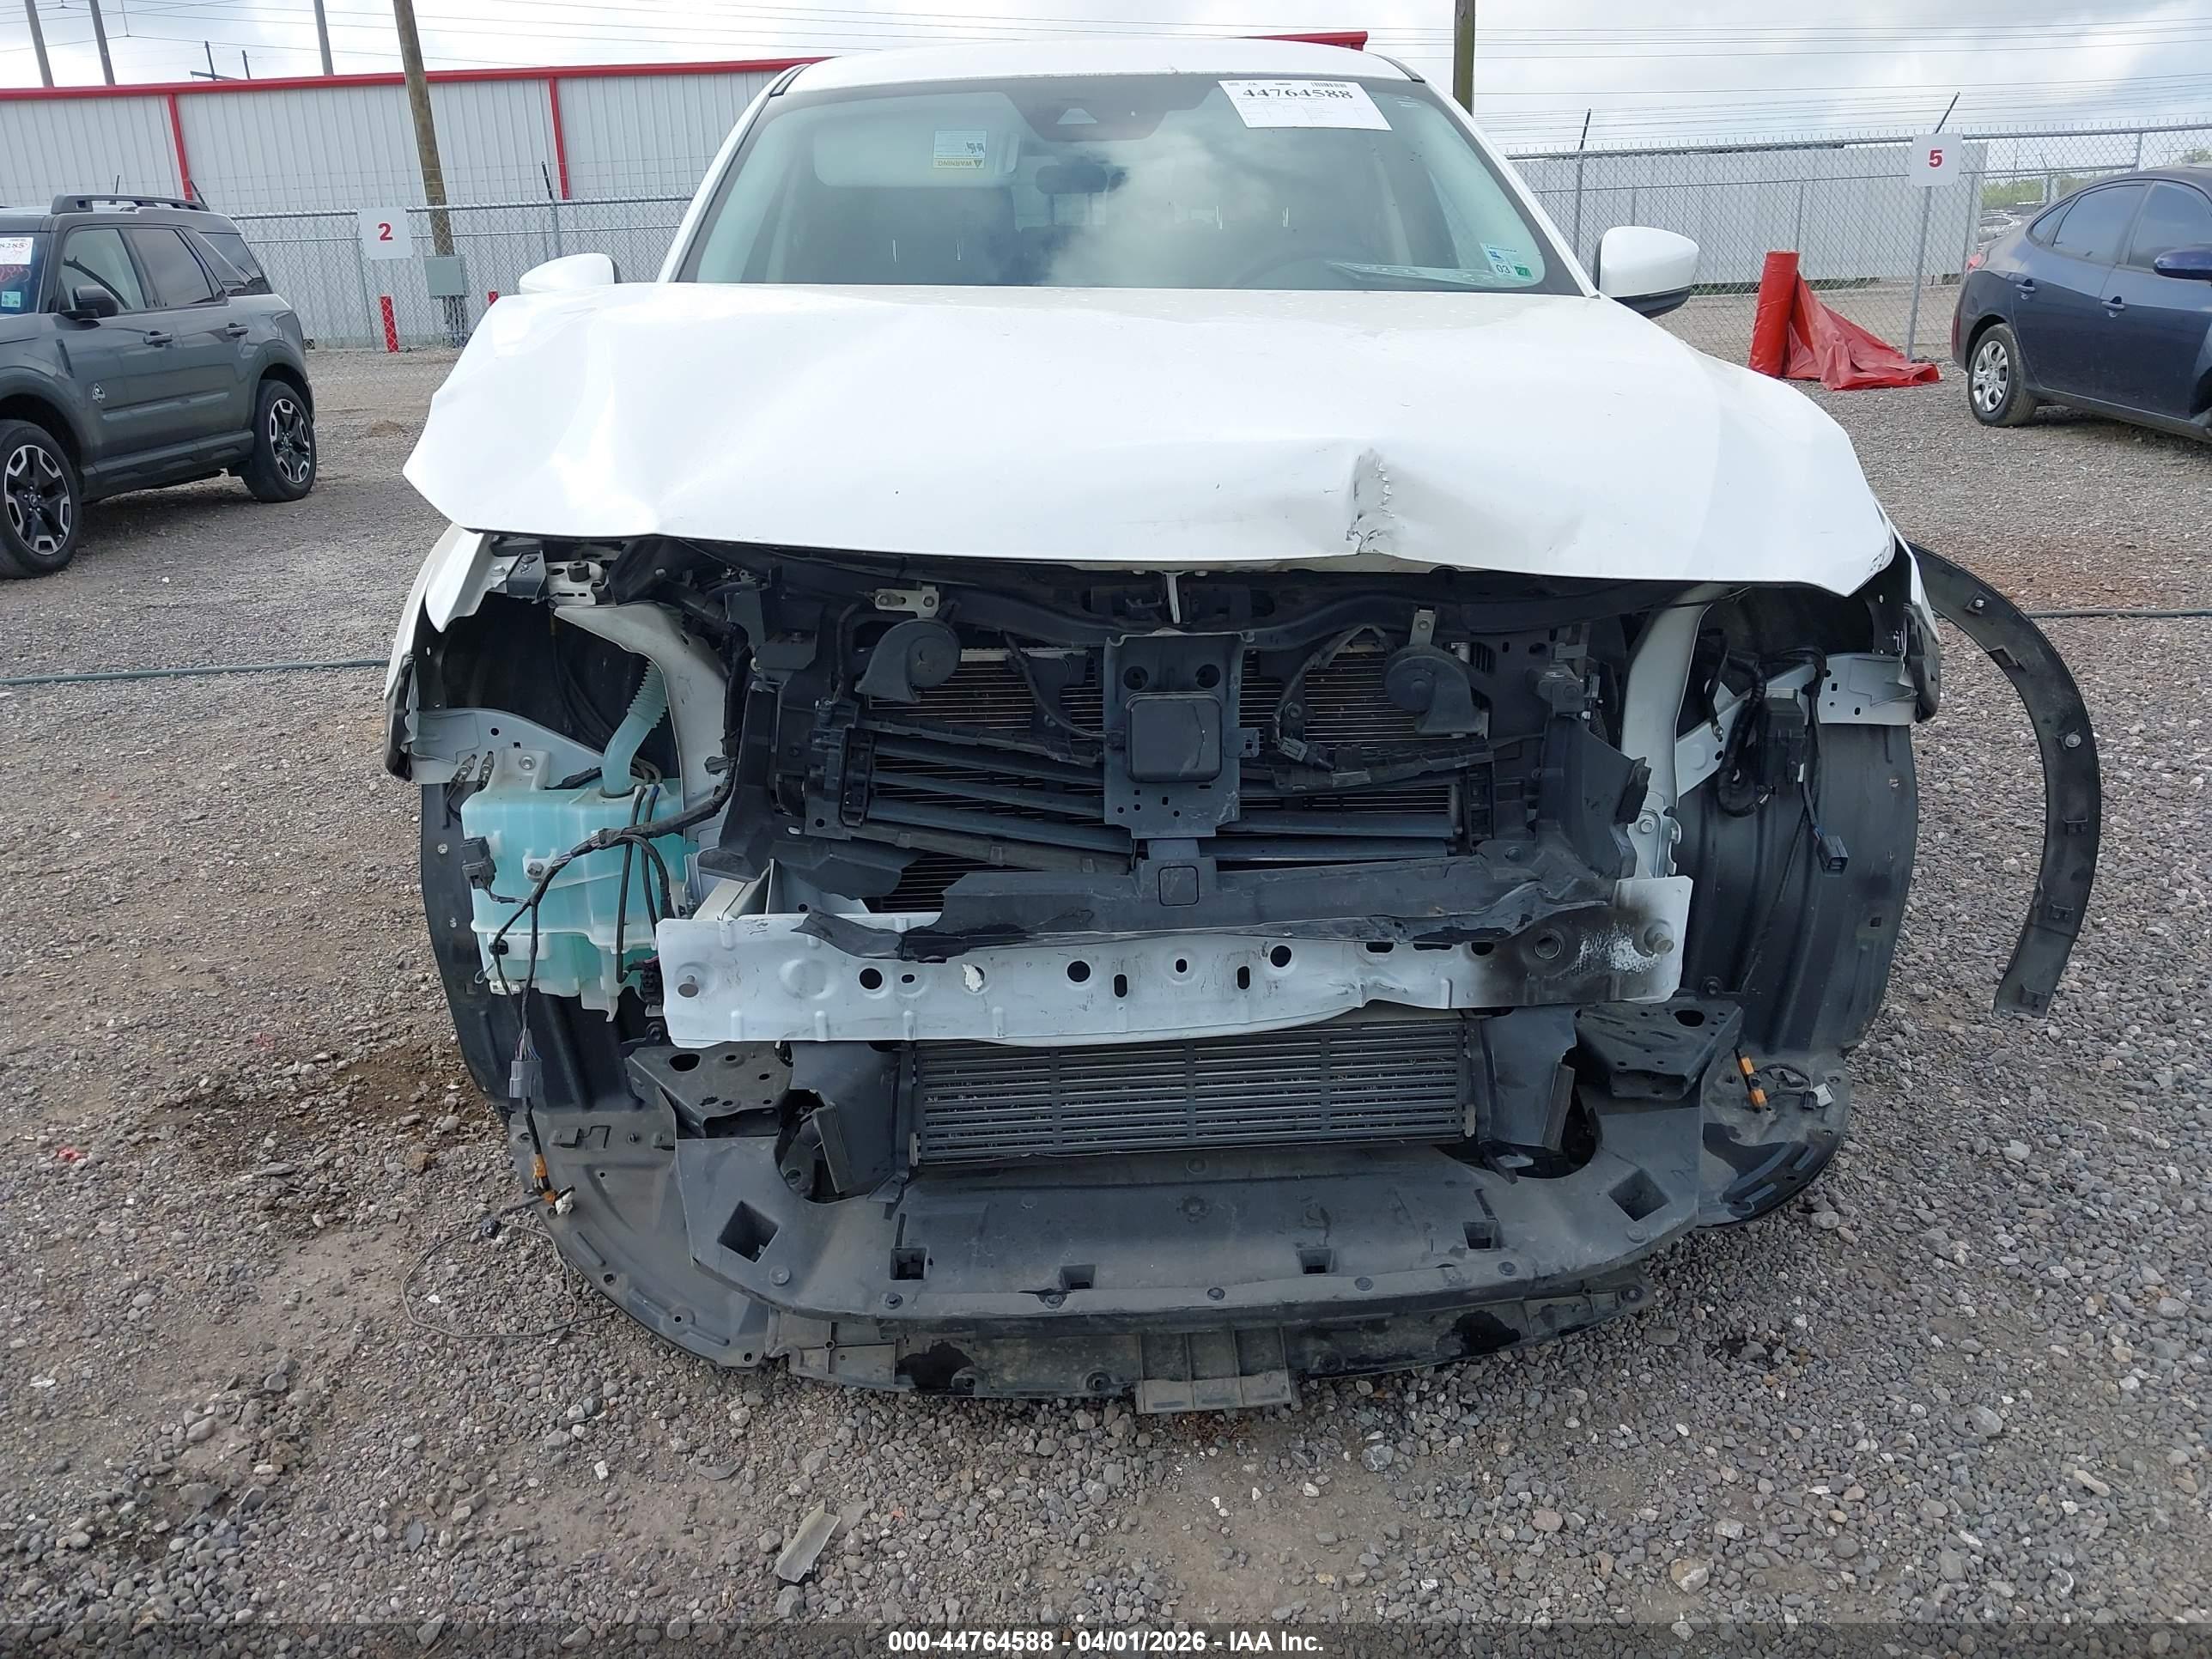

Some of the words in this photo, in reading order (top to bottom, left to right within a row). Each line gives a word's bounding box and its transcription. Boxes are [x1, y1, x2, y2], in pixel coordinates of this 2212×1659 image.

[1243, 88, 1354, 100] 44764588
[1929, 149, 1943, 167] 5
[378, 222, 393, 240] 2
[1496, 264, 1511, 274] 03
